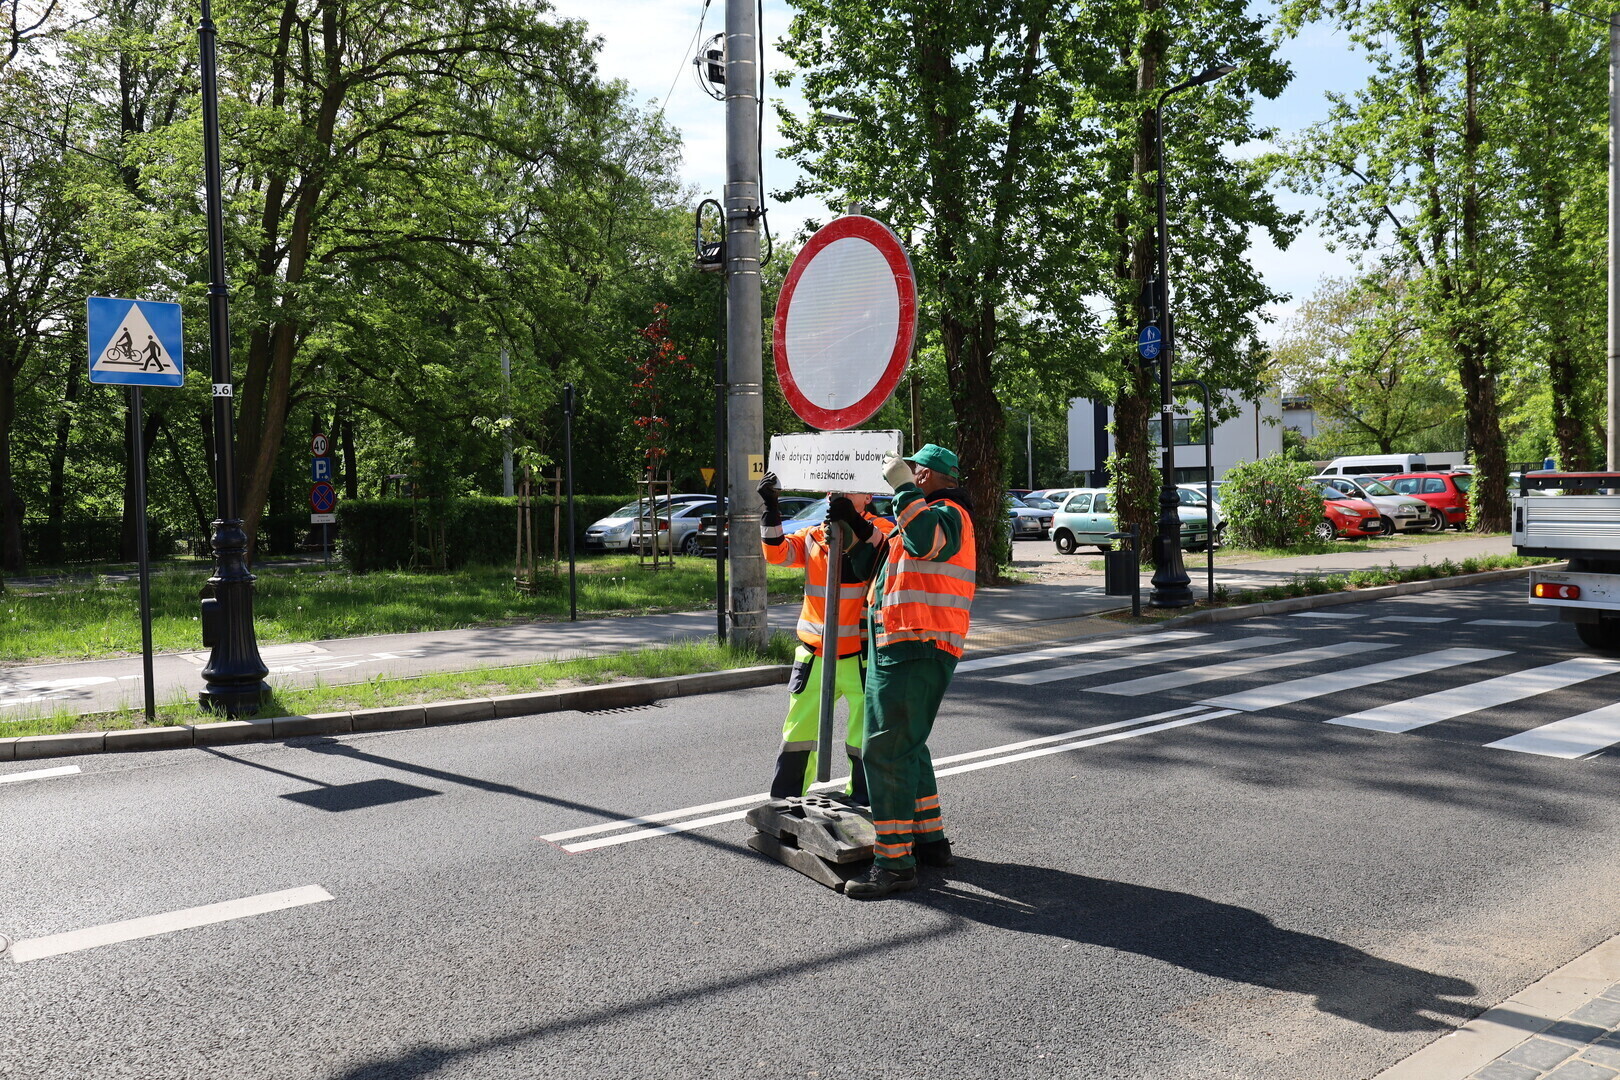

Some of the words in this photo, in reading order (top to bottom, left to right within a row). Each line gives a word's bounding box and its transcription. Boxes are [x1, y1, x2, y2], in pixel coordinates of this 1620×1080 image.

[314, 440, 326, 452] 40
[775, 451, 785, 461] Nie
[789, 452, 812, 464] dotyczy
[816, 450, 851, 464] pojazdów
[315, 460, 327, 479] P
[752, 462, 763, 473] 12
[810, 468, 855, 481] mieszkańców
